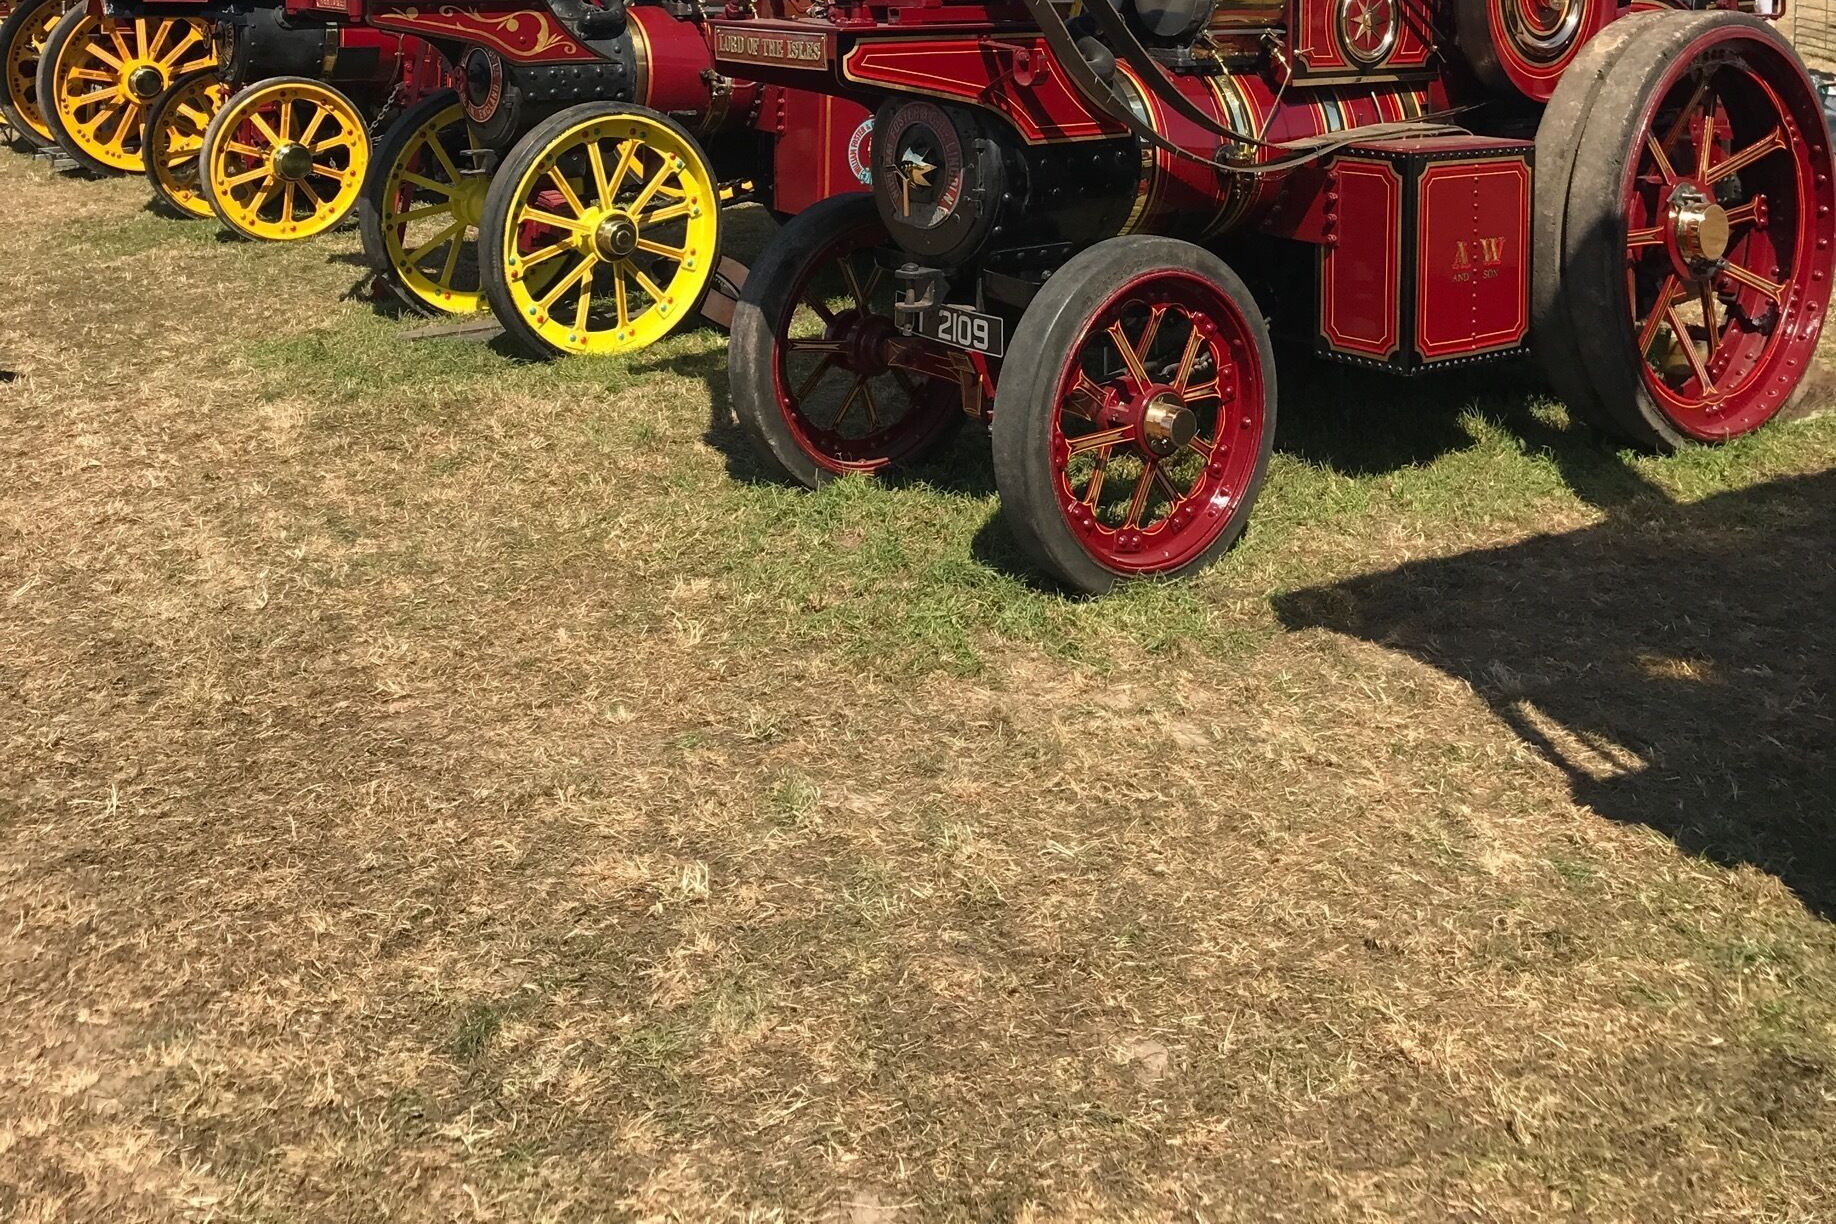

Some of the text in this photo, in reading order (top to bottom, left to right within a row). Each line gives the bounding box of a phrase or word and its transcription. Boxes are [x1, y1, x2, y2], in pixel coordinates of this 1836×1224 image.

[719, 33, 821, 61] LORD OF THE ISLES
[889, 106, 920, 139] FOSTER
[1479, 236, 1506, 266] W
[1453, 269, 1499, 282] AND SON
[938, 309, 989, 351] 2109
